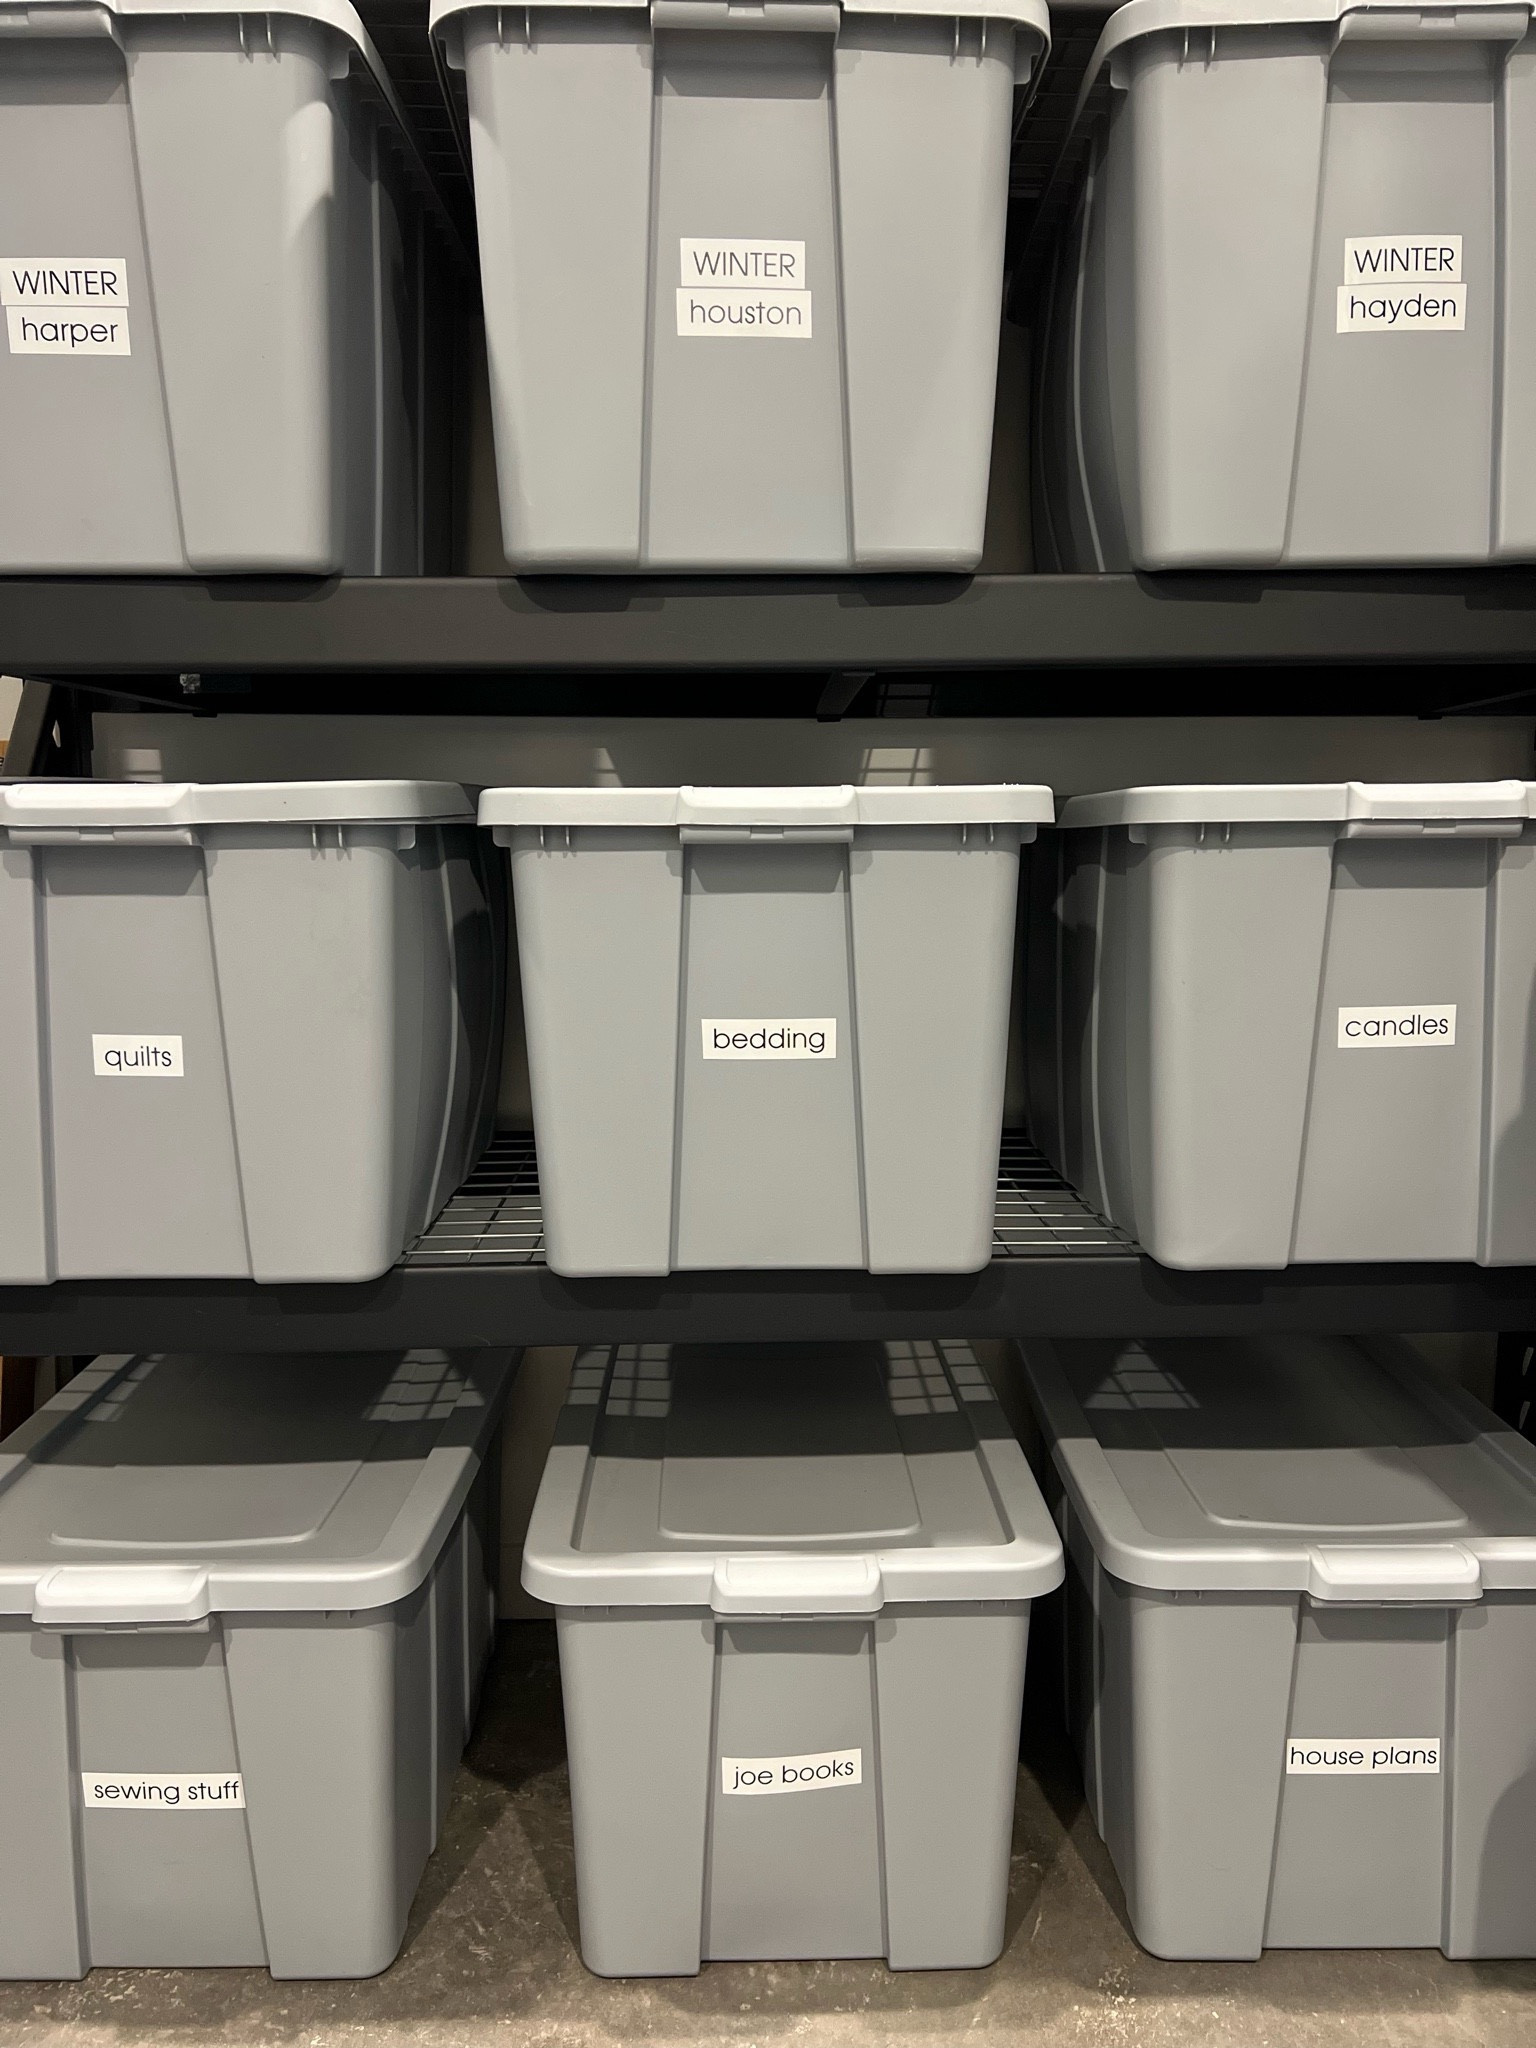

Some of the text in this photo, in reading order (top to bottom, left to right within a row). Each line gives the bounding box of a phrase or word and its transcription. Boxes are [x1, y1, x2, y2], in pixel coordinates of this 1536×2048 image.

[693, 251, 796, 278] WINTER
[1353, 247, 1455, 274] WINTER
[12, 270, 118, 296] WINTER
[690, 299, 801, 325] houston
[1350, 292, 1457, 324] hayden
[21, 316, 119, 348] harper
[1345, 1014, 1449, 1037] candles
[713, 1027, 825, 1054] bedding
[104, 1045, 172, 1072] quilts
[1290, 1746, 1437, 1770] house plans
[732, 1758, 855, 1790] joe books
[94, 1779, 241, 1805] sewing stuff
